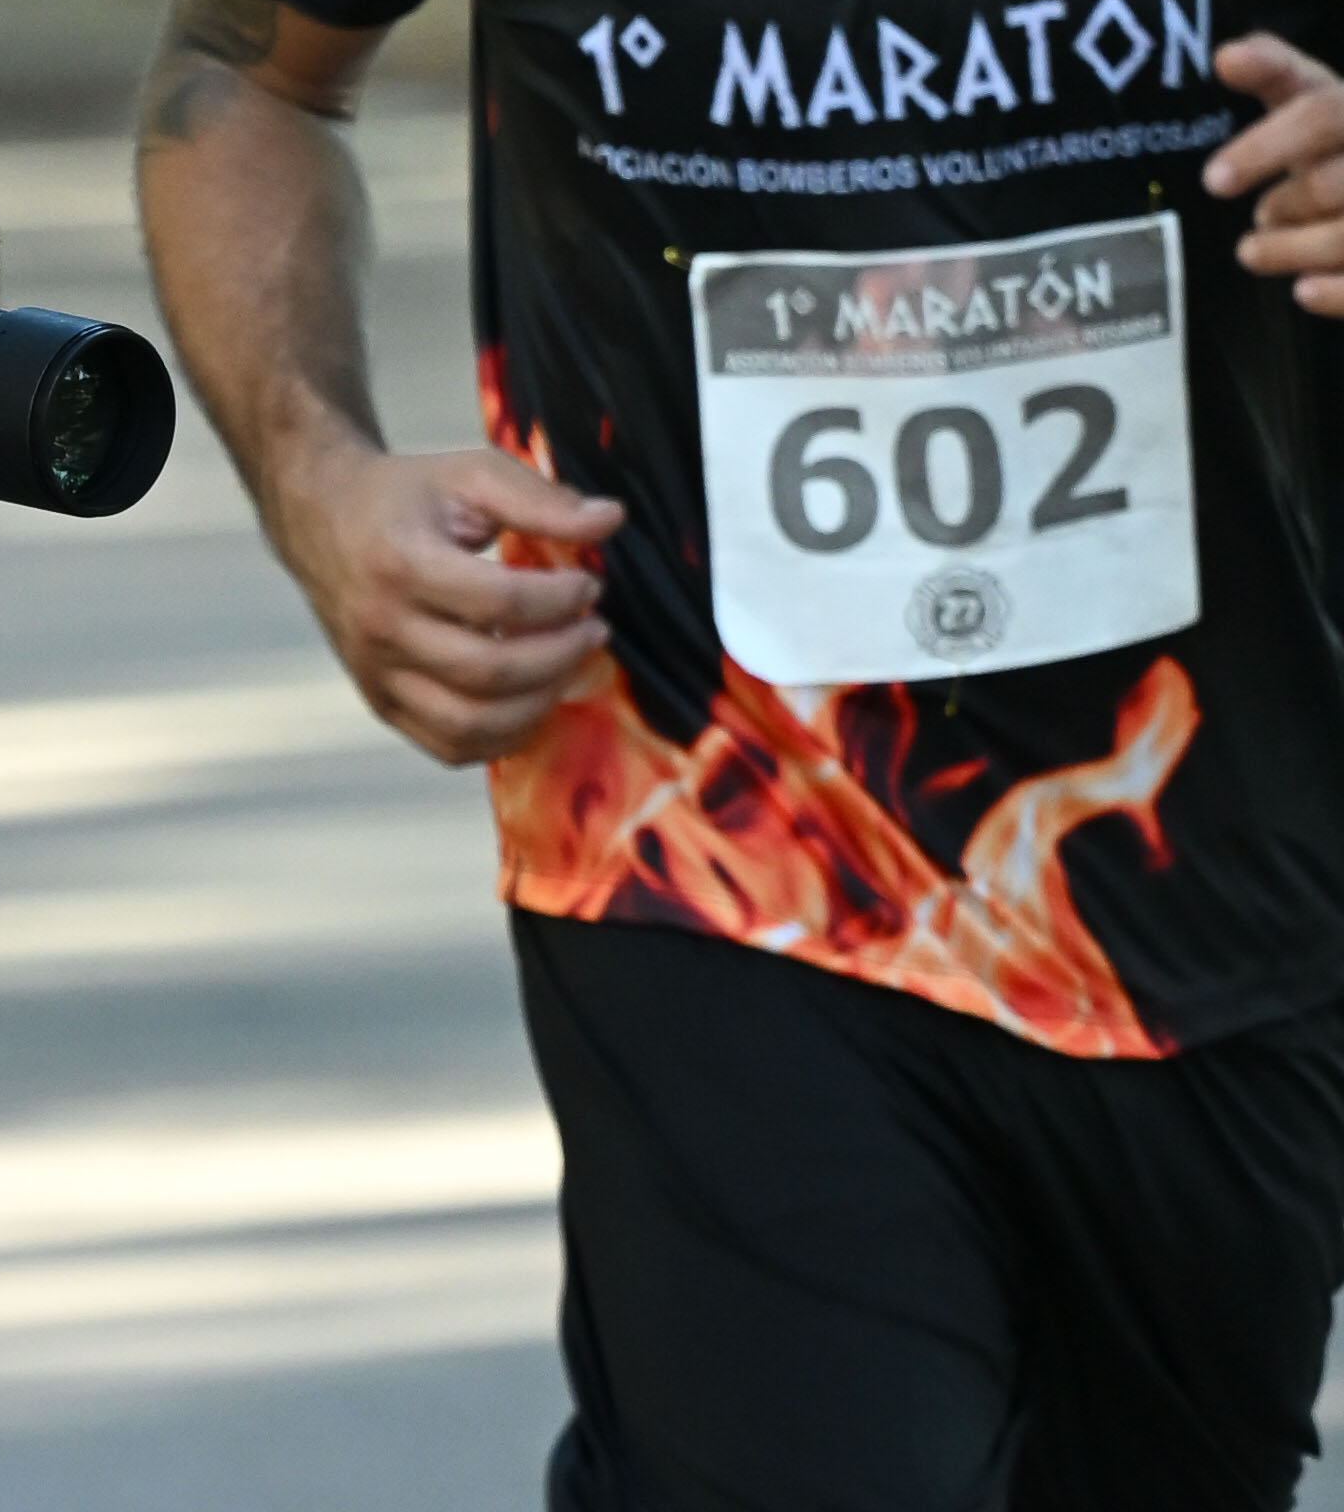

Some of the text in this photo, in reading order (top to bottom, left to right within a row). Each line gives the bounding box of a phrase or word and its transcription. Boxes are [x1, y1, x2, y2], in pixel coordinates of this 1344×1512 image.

[737, 155, 918, 194] BOMBEROS
[832, 253, 1115, 342] MARATÓN
[769, 383, 1130, 555] 602
